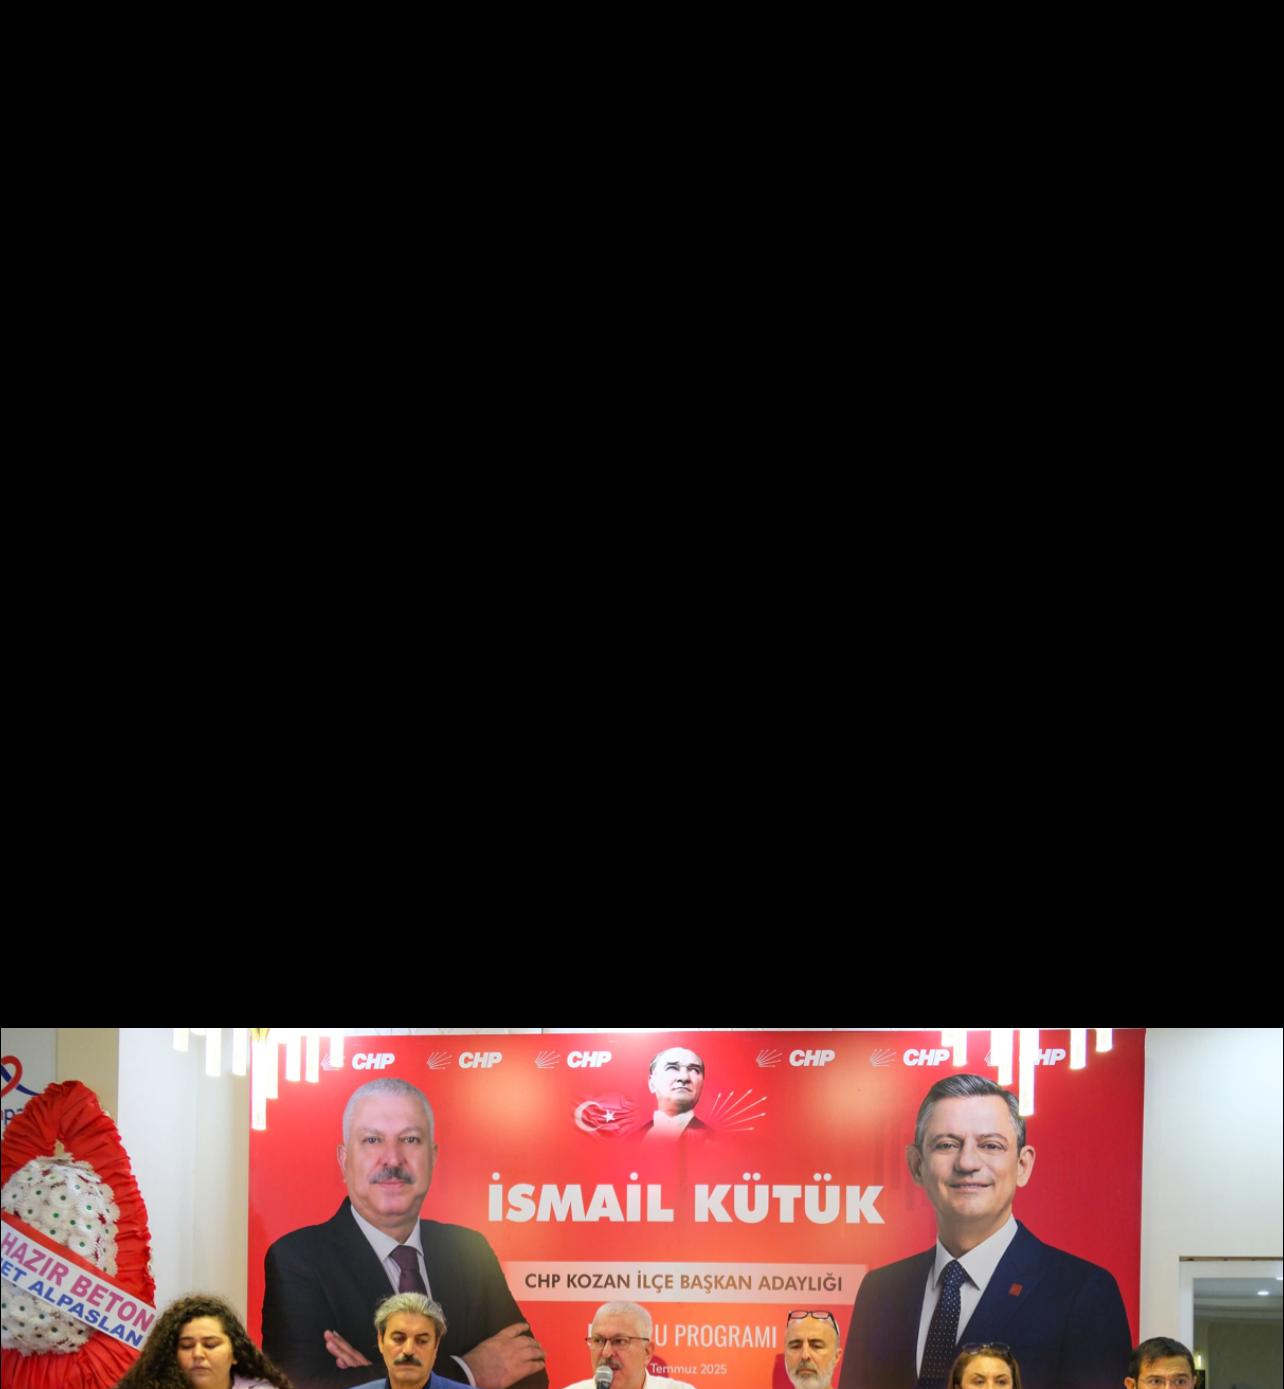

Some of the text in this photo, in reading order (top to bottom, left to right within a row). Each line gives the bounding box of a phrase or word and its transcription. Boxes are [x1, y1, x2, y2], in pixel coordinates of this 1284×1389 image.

[351, 1052, 396, 1070] CHP
[458, 1051, 502, 1069] CHP
[566, 1050, 612, 1068] CHP
[789, 1049, 836, 1067] CHP
[903, 1048, 950, 1067] CHP
[1024, 1048, 1066, 1066] HP
[488, 1171, 886, 1224] İSMAİL KÜTÜK
[1, 1232, 155, 1332] HAZIR BETON
[524, 1269, 843, 1294] CHP KOZAN İLÇE BAŞKAN ADAYLIĞI
[1, 1260, 143, 1347] ET ALPASLAN
[674, 1325, 777, 1349] PROGRAMI
[650, 1363, 728, 1375] Temmuz 2025
